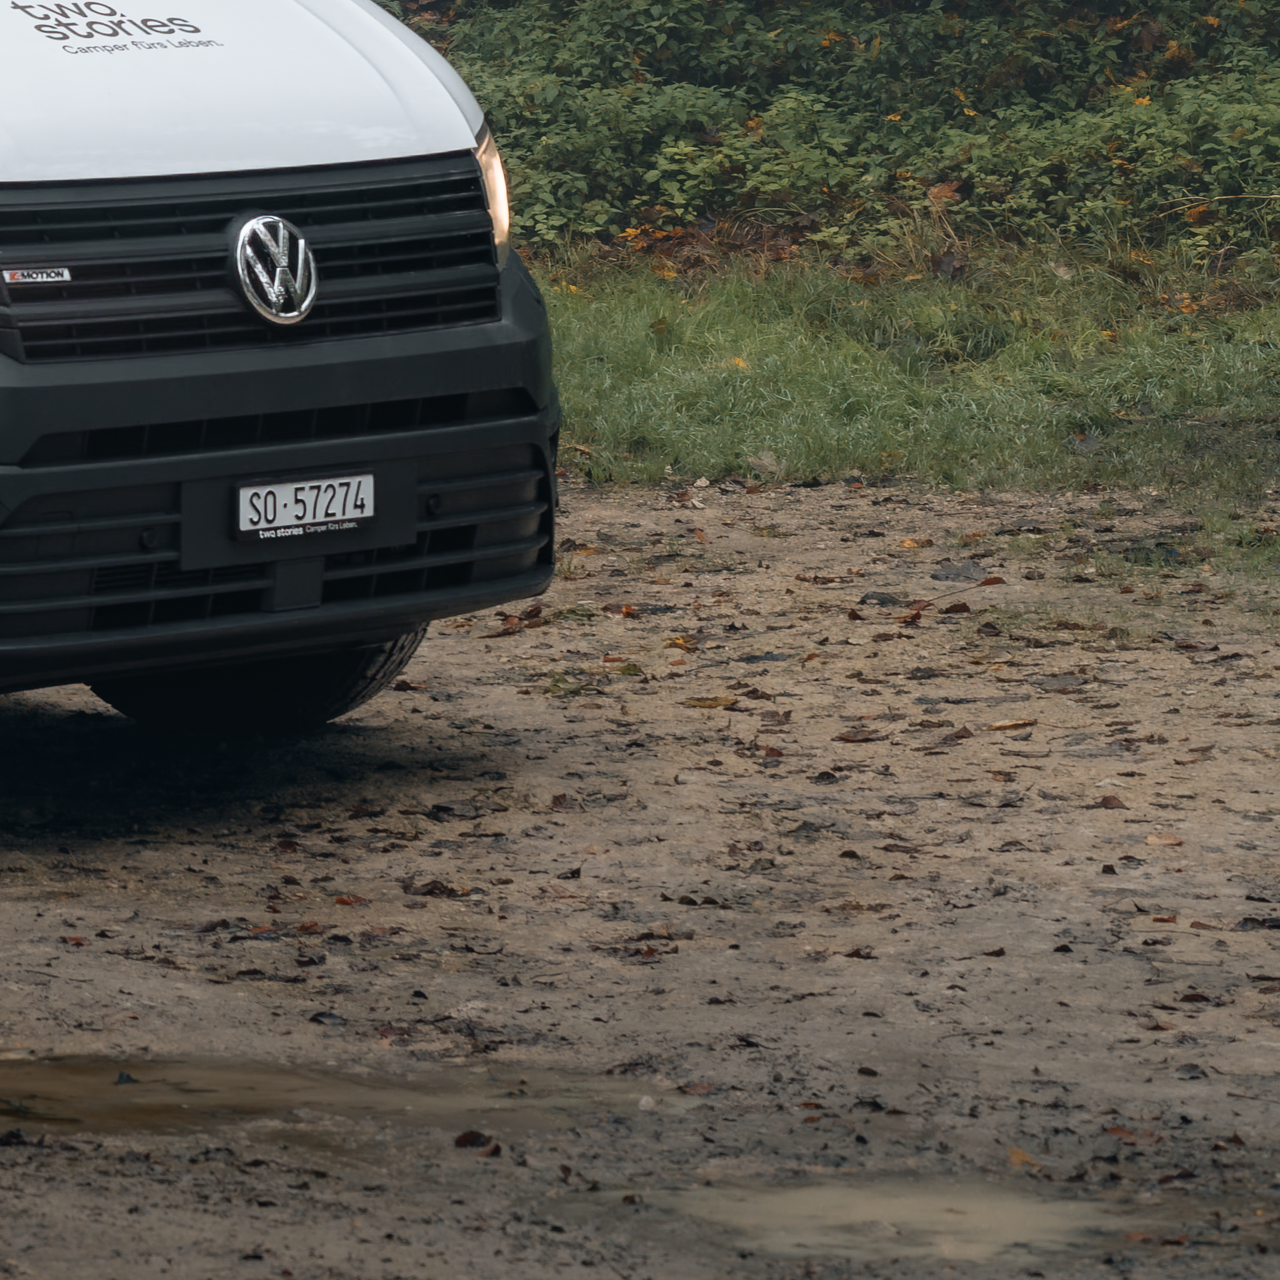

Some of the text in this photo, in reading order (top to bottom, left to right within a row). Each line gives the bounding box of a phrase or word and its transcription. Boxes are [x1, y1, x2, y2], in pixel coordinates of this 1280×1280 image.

[10, 0, 118, 21] two
[34, 13, 202, 41] stories
[62, 44, 130, 55] Camper
